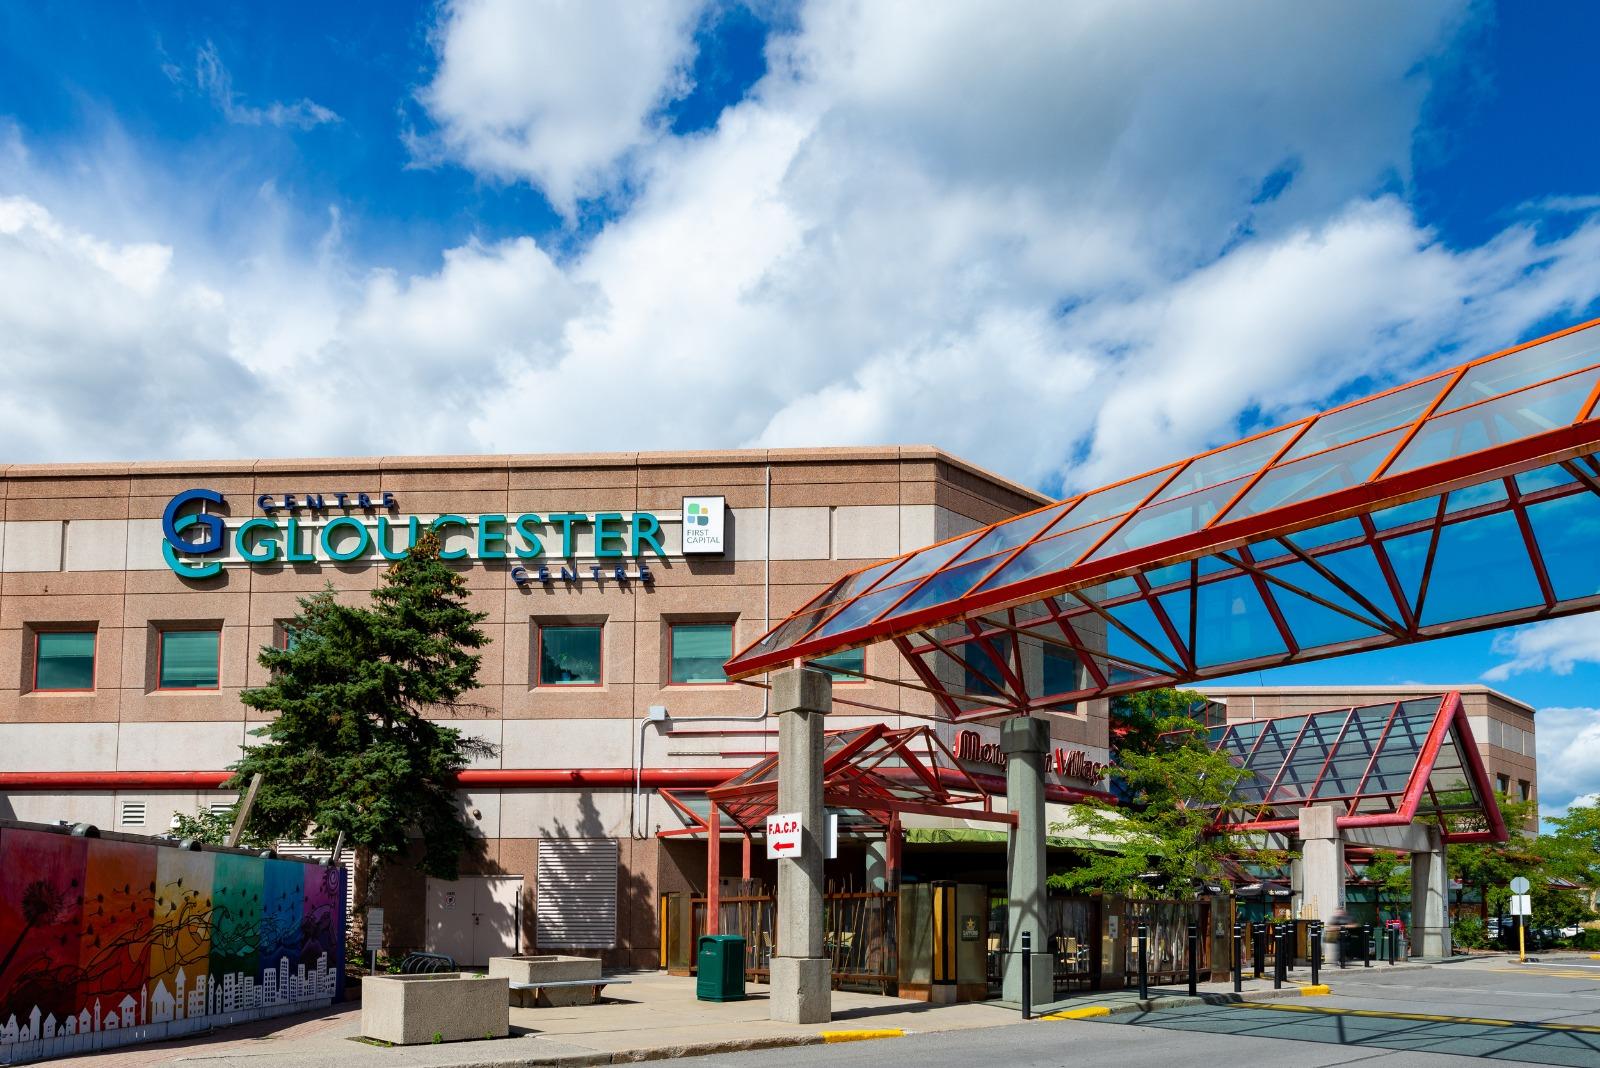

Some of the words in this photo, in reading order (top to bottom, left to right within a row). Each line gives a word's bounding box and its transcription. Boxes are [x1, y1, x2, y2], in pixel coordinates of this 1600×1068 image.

[257, 492, 394, 512] CENTRE
[235, 512, 667, 564] GLOUCESTER
[511, 565, 650, 585] CENTRE
[768, 821, 800, 835] F.A.C.P.
